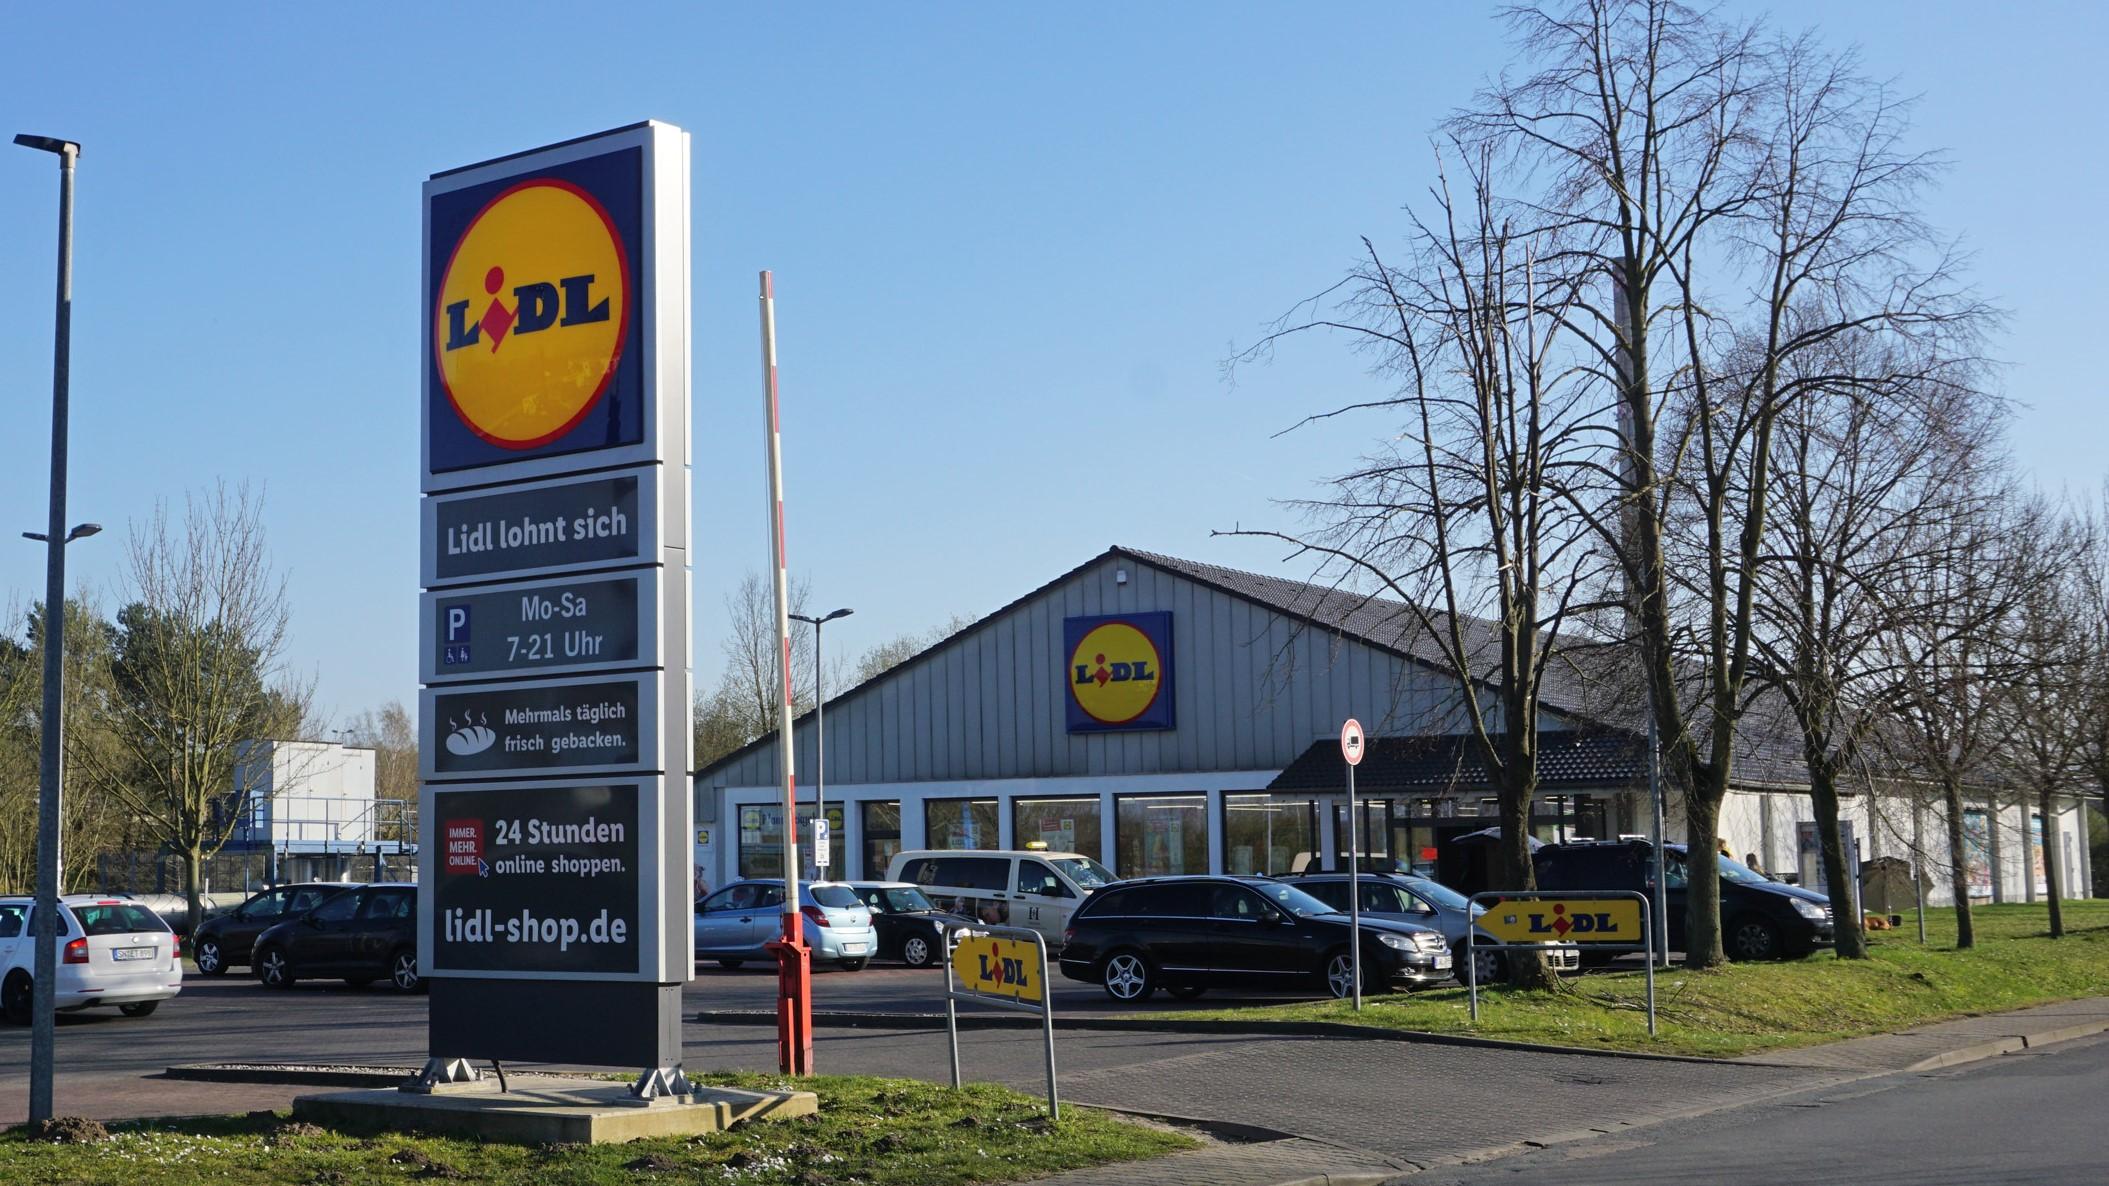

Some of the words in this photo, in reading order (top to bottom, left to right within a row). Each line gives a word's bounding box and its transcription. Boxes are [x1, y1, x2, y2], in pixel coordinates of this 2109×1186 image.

[448, 523, 493, 555] Lidl
[500, 516, 566, 549] lohnt
[573, 506, 627, 540] sich
[521, 592, 587, 622] Mo-Sa
[449, 608, 466, 641] P
[507, 633, 554, 662] 7-21
[565, 630, 602, 657] Uhr
[505, 705, 572, 725] Mehrmals
[577, 702, 626, 724] täglich
[505, 734, 544, 752] frisch
[551, 731, 626, 753] gebacken.
[449, 828, 477, 838] IMMER.
[495, 819, 522, 845] 24
[528, 817, 624, 845] Stunden
[449, 841, 477, 853] MEHR.
[495, 855, 545, 874] online
[552, 855, 626, 877] shoppen.
[445, 908, 627, 951] lidl-shop.de
